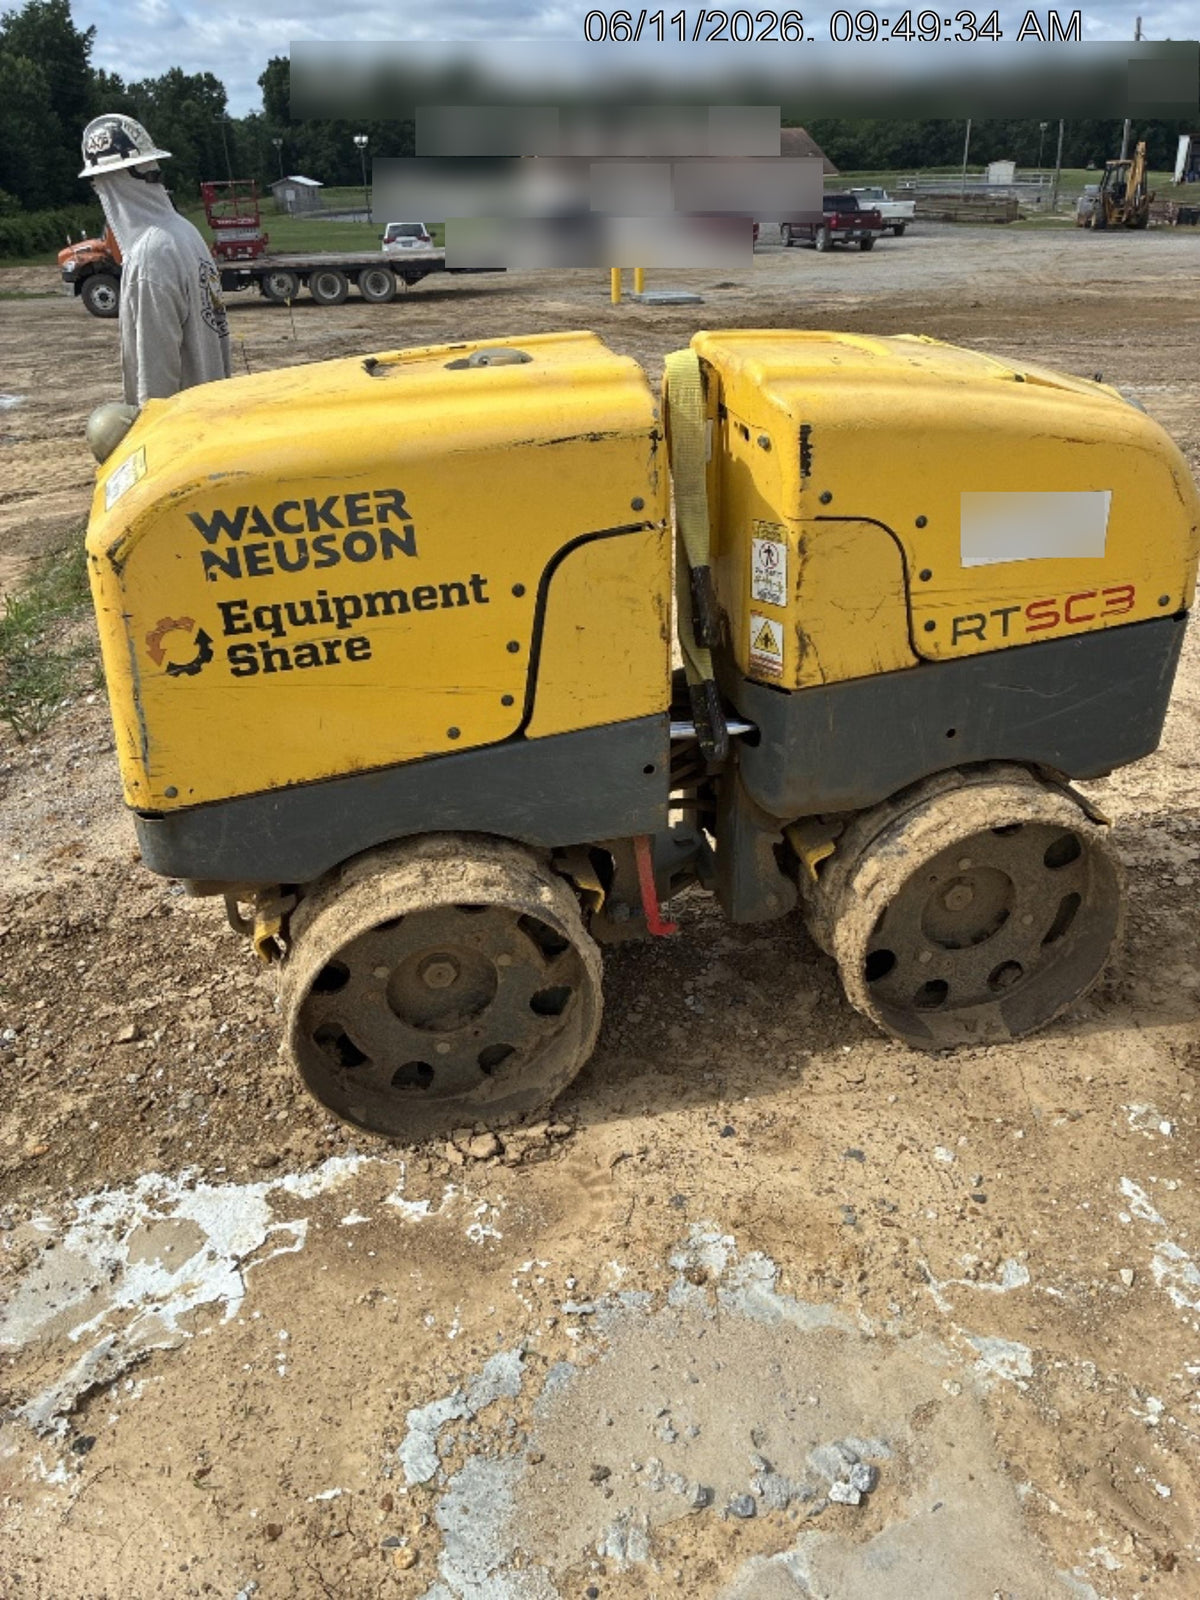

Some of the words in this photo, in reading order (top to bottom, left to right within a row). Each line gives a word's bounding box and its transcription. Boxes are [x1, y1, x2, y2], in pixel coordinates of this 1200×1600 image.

[185, 488, 413, 544] WACKER
[200, 524, 418, 582] NEUSON
[217, 574, 489, 637] Equipment
[227, 636, 372, 678] Share
